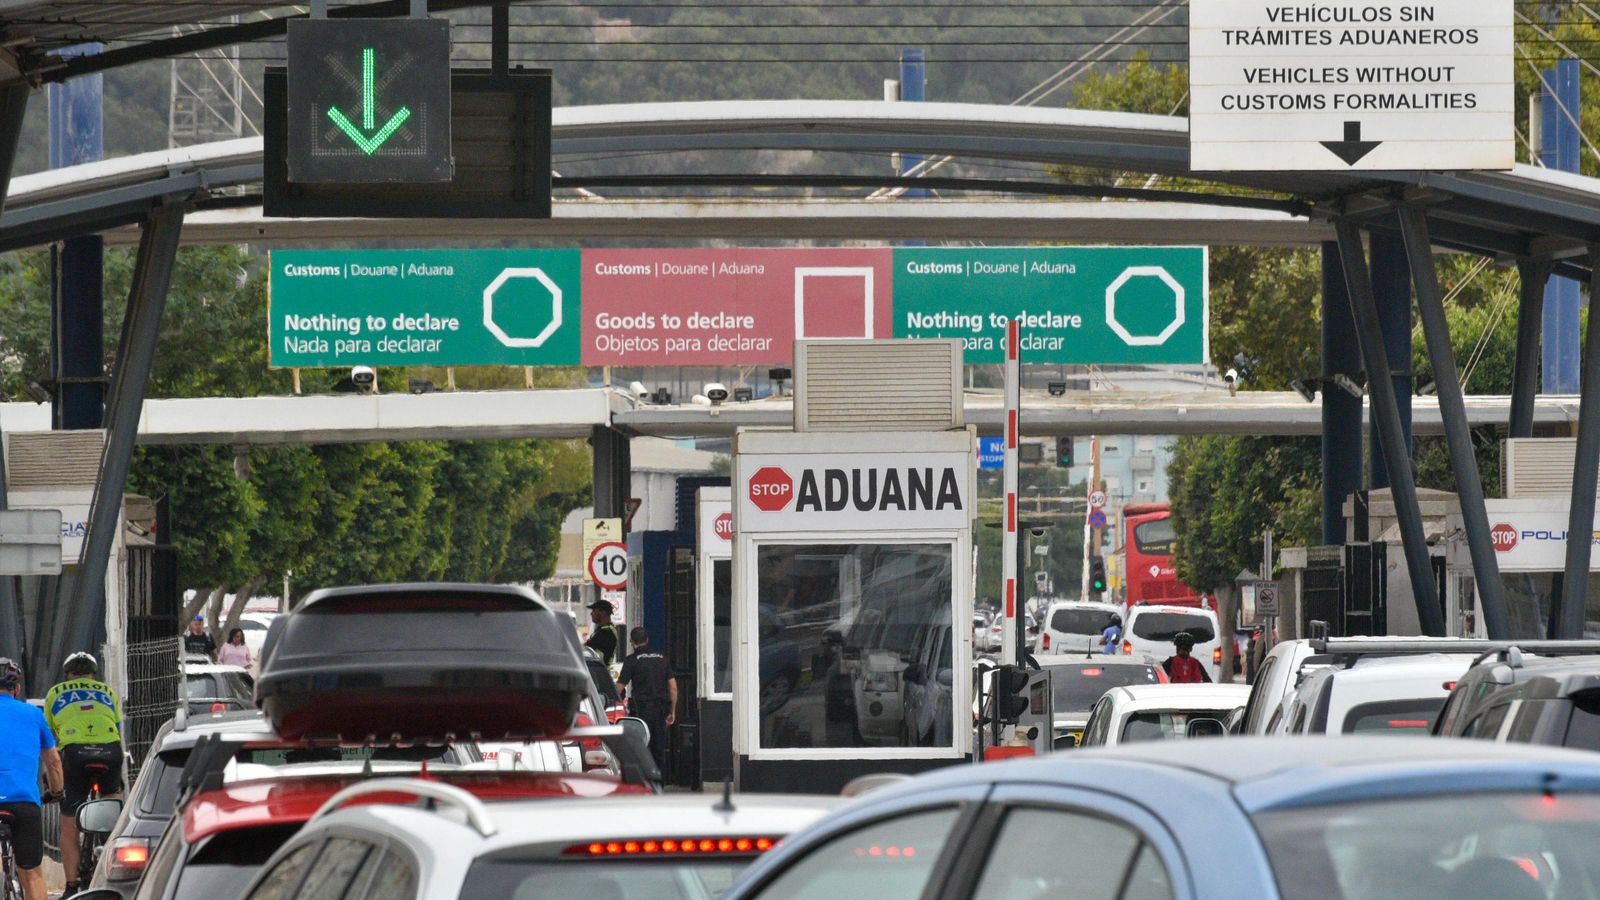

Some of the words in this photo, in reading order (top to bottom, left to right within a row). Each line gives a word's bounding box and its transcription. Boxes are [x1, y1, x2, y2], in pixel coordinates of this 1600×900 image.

[1266, 4, 1392, 22] VEHÍCULOS
[1399, 6, 1434, 22] SIN
[1221, 26, 1332, 46] TRÁMITES
[1339, 28, 1479, 45] ADUANEROS
[1243, 67, 1349, 84] VEHICLES
[1355, 66, 1456, 83] WITHOUT
[1221, 94, 1326, 111] CUSTOMS
[1333, 93, 1477, 110] FORMALITIES
[284, 263, 341, 277] Customs
[351, 263, 398, 276] Douane
[408, 263, 454, 276] Aduana
[595, 262, 651, 275] Customs
[662, 262, 709, 275] Douane
[719, 262, 765, 275] Aduana
[906, 261, 963, 275] Customs
[973, 261, 1020, 274] Douane
[1030, 261, 1076, 274] Aduana
[284, 313, 361, 335] Nothing
[366, 315, 387, 331] to
[392, 313, 460, 331] declare
[595, 312, 656, 330] Goods
[661, 314, 682, 330] to
[687, 312, 755, 330] declare
[907, 311, 983, 333] Nothing
[989, 313, 1009, 329] to
[1014, 310, 1082, 328] declare
[284, 336, 329, 354] Nada
[335, 339, 371, 357] para
[376, 335, 443, 354] declarar
[595, 334, 660, 356] Objetos
[665, 338, 701, 355] para
[707, 334, 773, 352] declarar
[752, 483, 790, 497] STOP
[795, 467, 963, 512] ADUANA
[716, 519, 732, 533] STO
[1521, 530, 1569, 540] POLI
[1491, 530, 1516, 545] STOP
[597, 554, 627, 576] 10
[57, 690, 113, 708] SAXO
